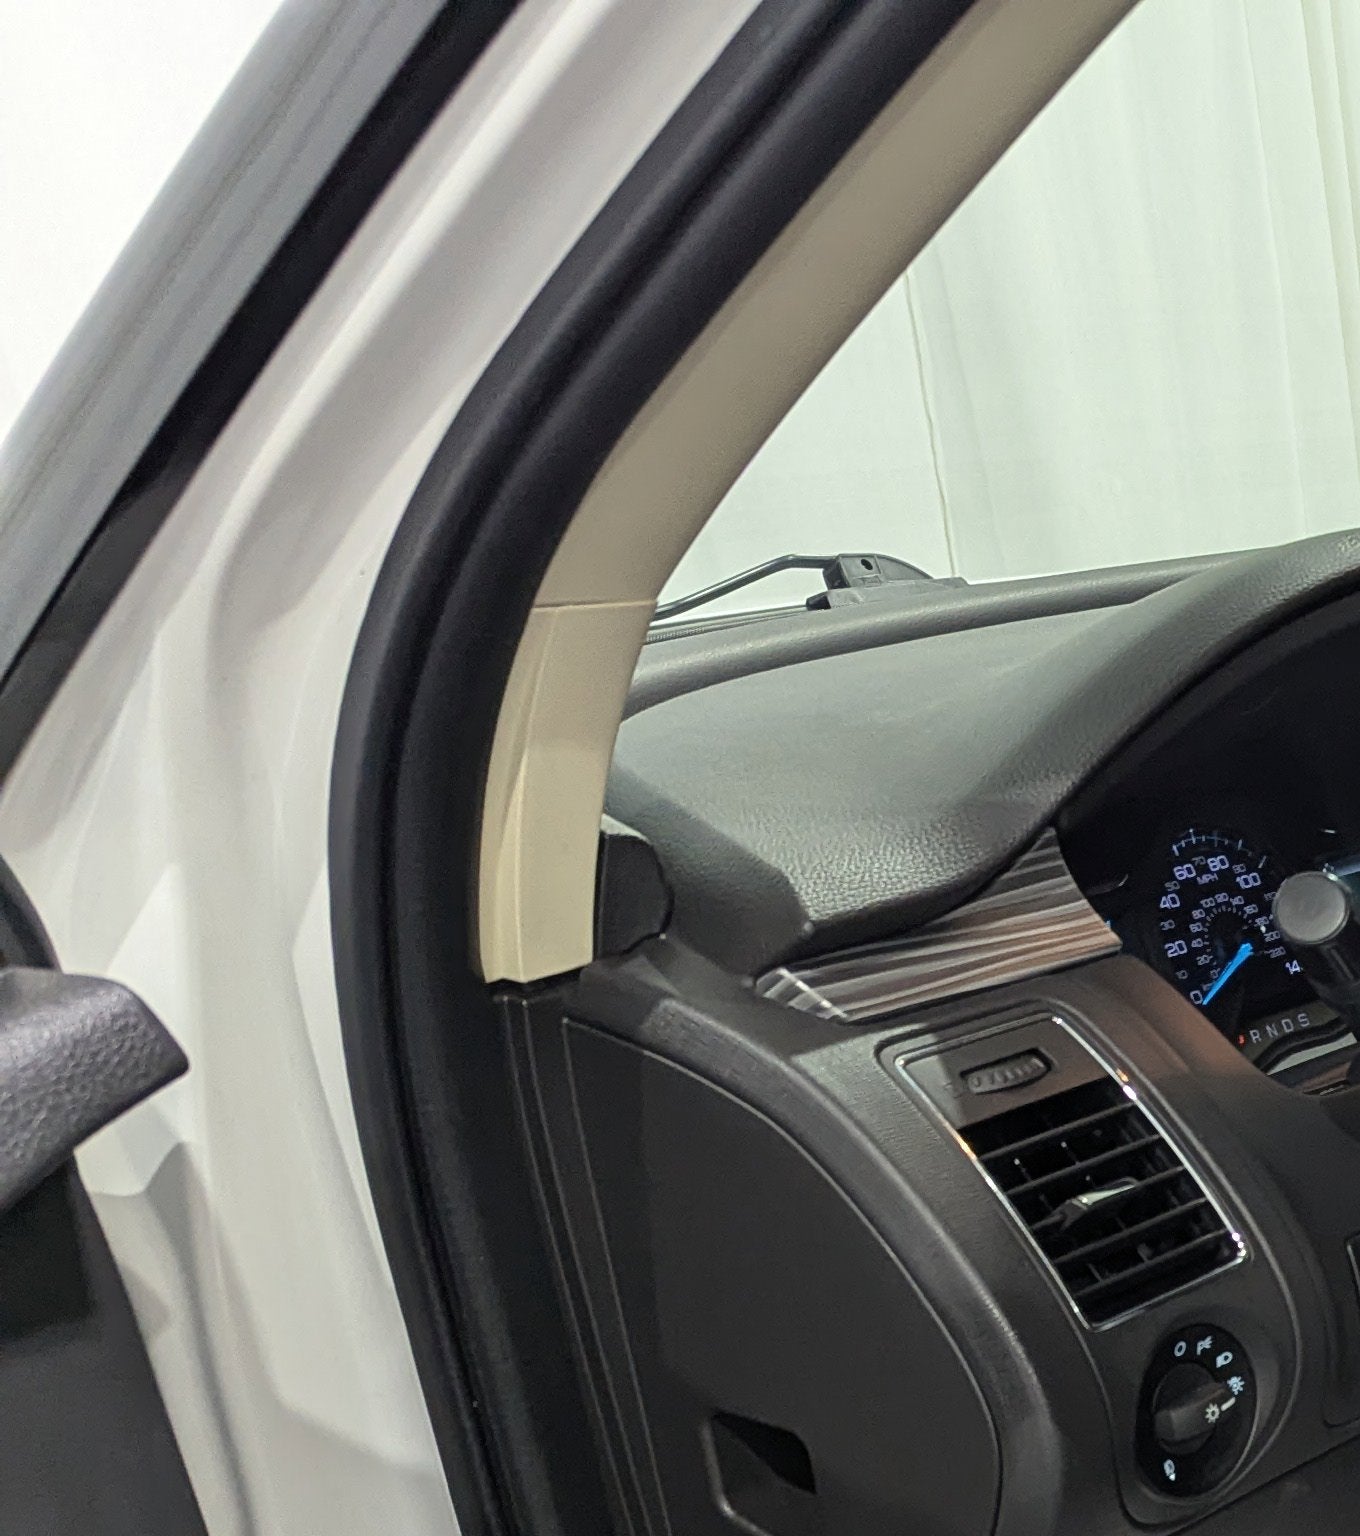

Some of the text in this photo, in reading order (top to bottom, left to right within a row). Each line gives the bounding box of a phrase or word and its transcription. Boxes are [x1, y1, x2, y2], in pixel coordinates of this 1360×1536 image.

[1207, 855, 1229, 871] 80
[1173, 863, 1196, 880] 60
[1236, 872, 1262, 889] 100
[1160, 893, 1180, 909] 40
[1164, 940, 1187, 958] 20
[1285, 960, 1301, 975] 14
[1190, 990, 1202, 1004] 0
[1249, 1029, 1261, 1043] R
[1265, 1023, 1278, 1038] N
[1281, 1018, 1294, 1033] D
[1297, 1012, 1310, 1027] S
